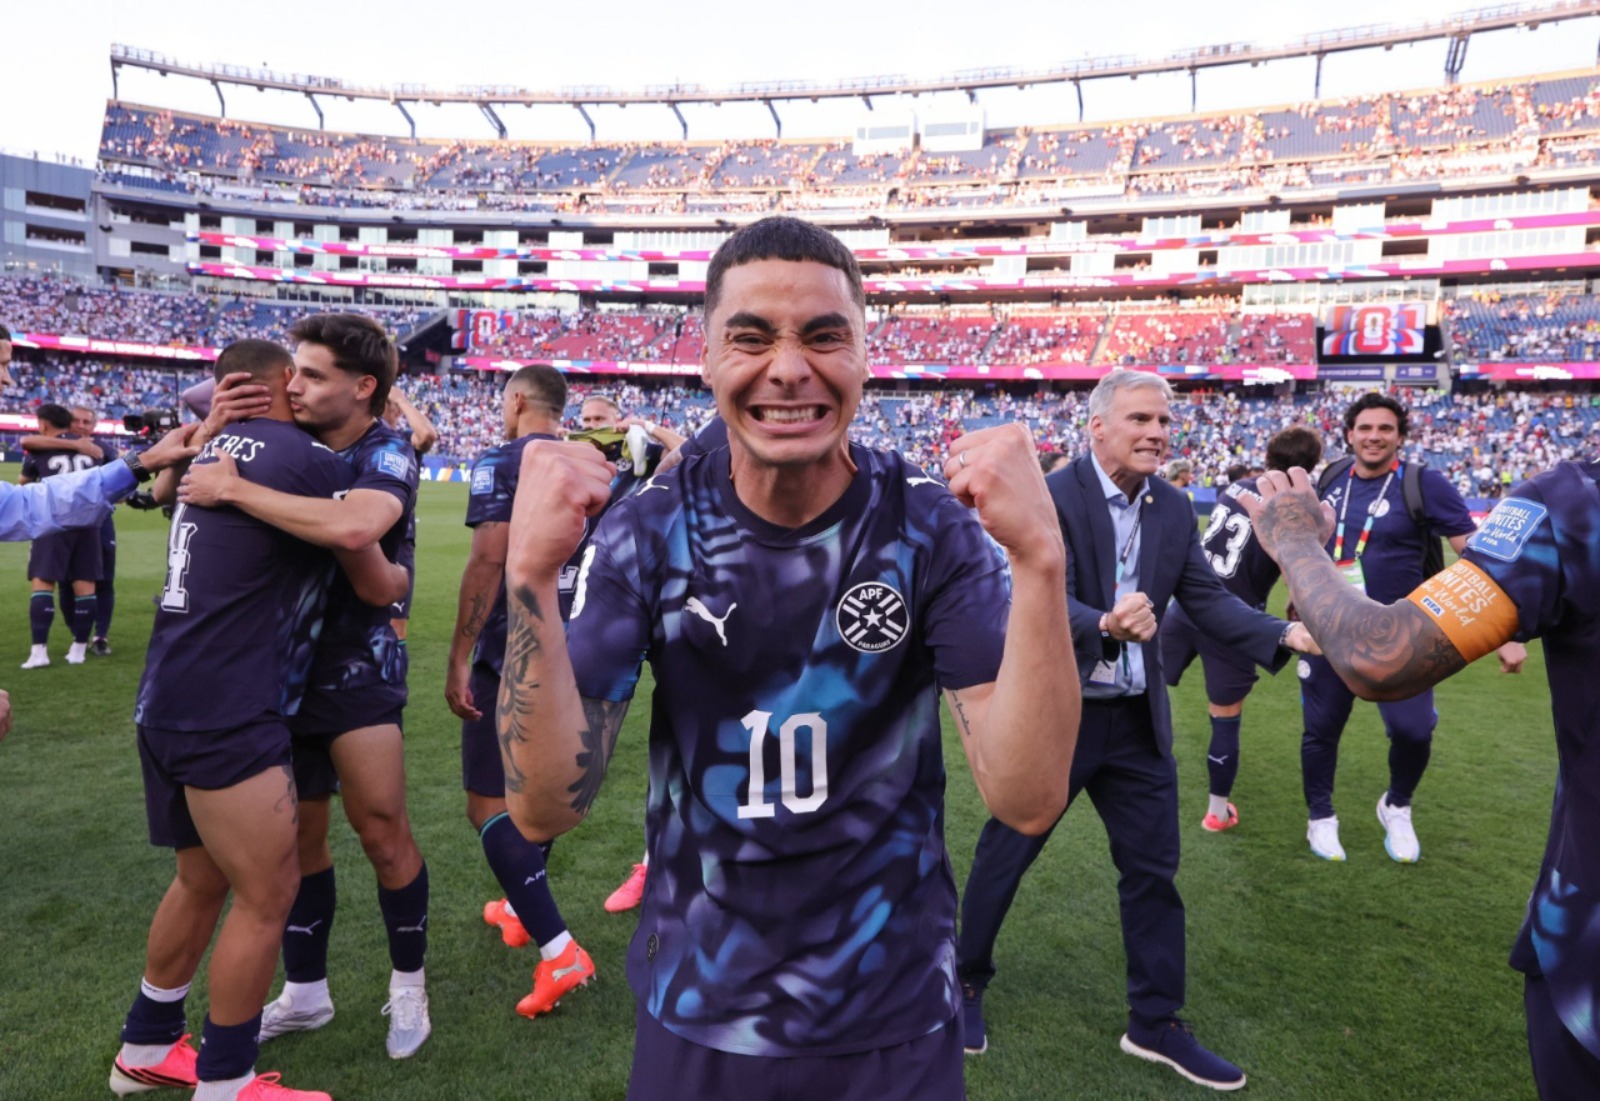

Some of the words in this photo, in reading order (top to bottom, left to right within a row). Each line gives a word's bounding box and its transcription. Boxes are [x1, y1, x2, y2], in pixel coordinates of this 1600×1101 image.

[1200, 503, 1252, 579] 23
[859, 588, 884, 601] APF
[1452, 562, 1498, 605] OOTBALL
[1422, 597, 1442, 616] FIFA
[1434, 588, 1476, 627] World
[857, 639, 891, 649] PARAGUAY
[737, 709, 829, 819] 10
